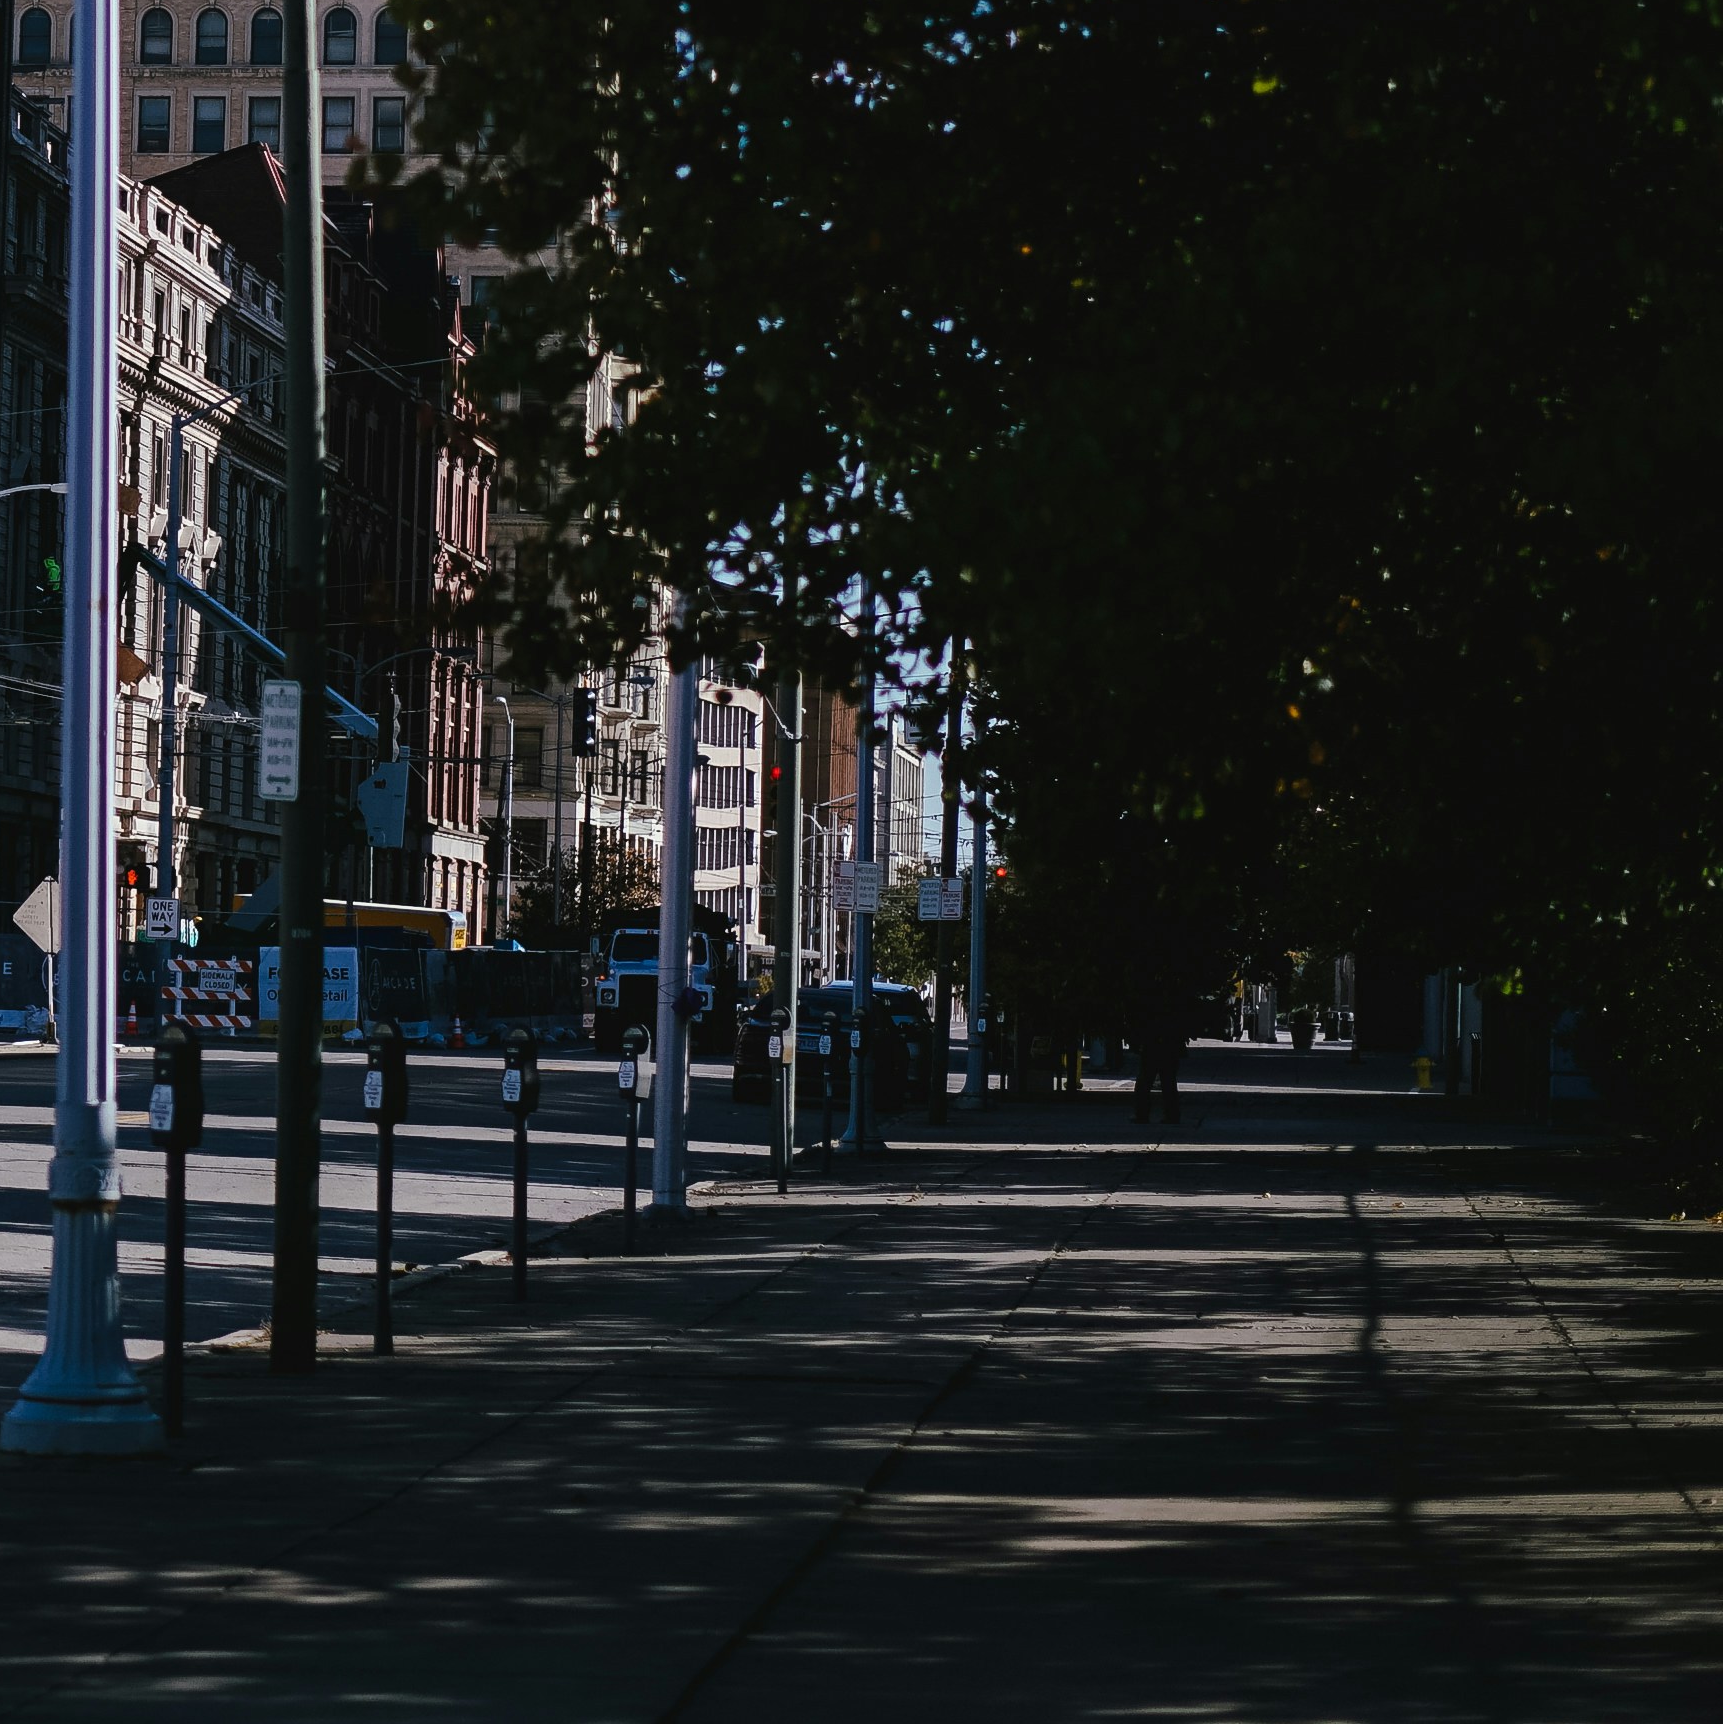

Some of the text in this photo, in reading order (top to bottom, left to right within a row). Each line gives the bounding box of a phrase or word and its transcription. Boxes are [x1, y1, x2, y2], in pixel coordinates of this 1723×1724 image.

[153, 901, 173, 911] ONE
[152, 912, 174, 922] WAY
[202, 972, 234, 980] SIDEWALK
[322, 967, 349, 980] ASE
[204, 981, 230, 989] CLOSED
[322, 989, 348, 1001] etail
